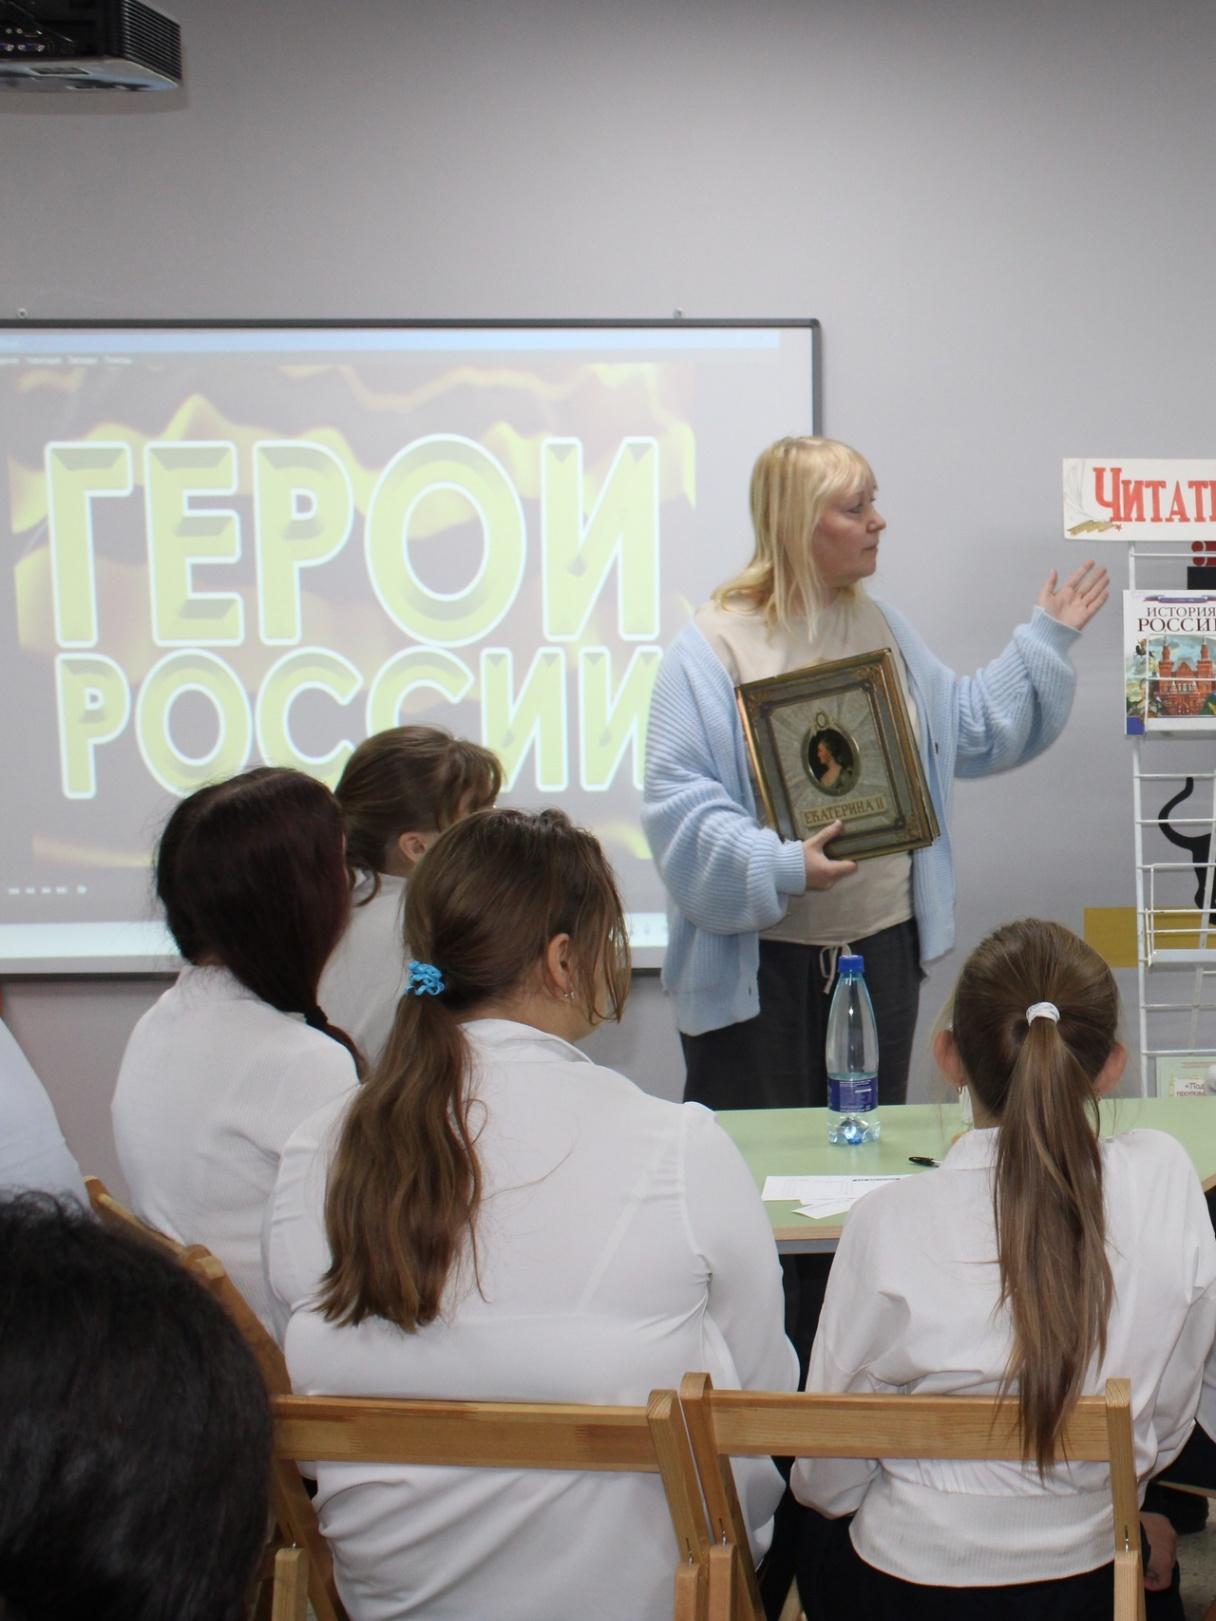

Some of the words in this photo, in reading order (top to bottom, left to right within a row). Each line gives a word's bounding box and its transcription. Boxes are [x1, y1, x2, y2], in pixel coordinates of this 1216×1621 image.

[44, 433, 661, 648] ГЕРОИ
[1146, 607, 1216, 617] ИСТОРИЯ
[805, 799, 874, 824] ЕКАТЕРИНА
